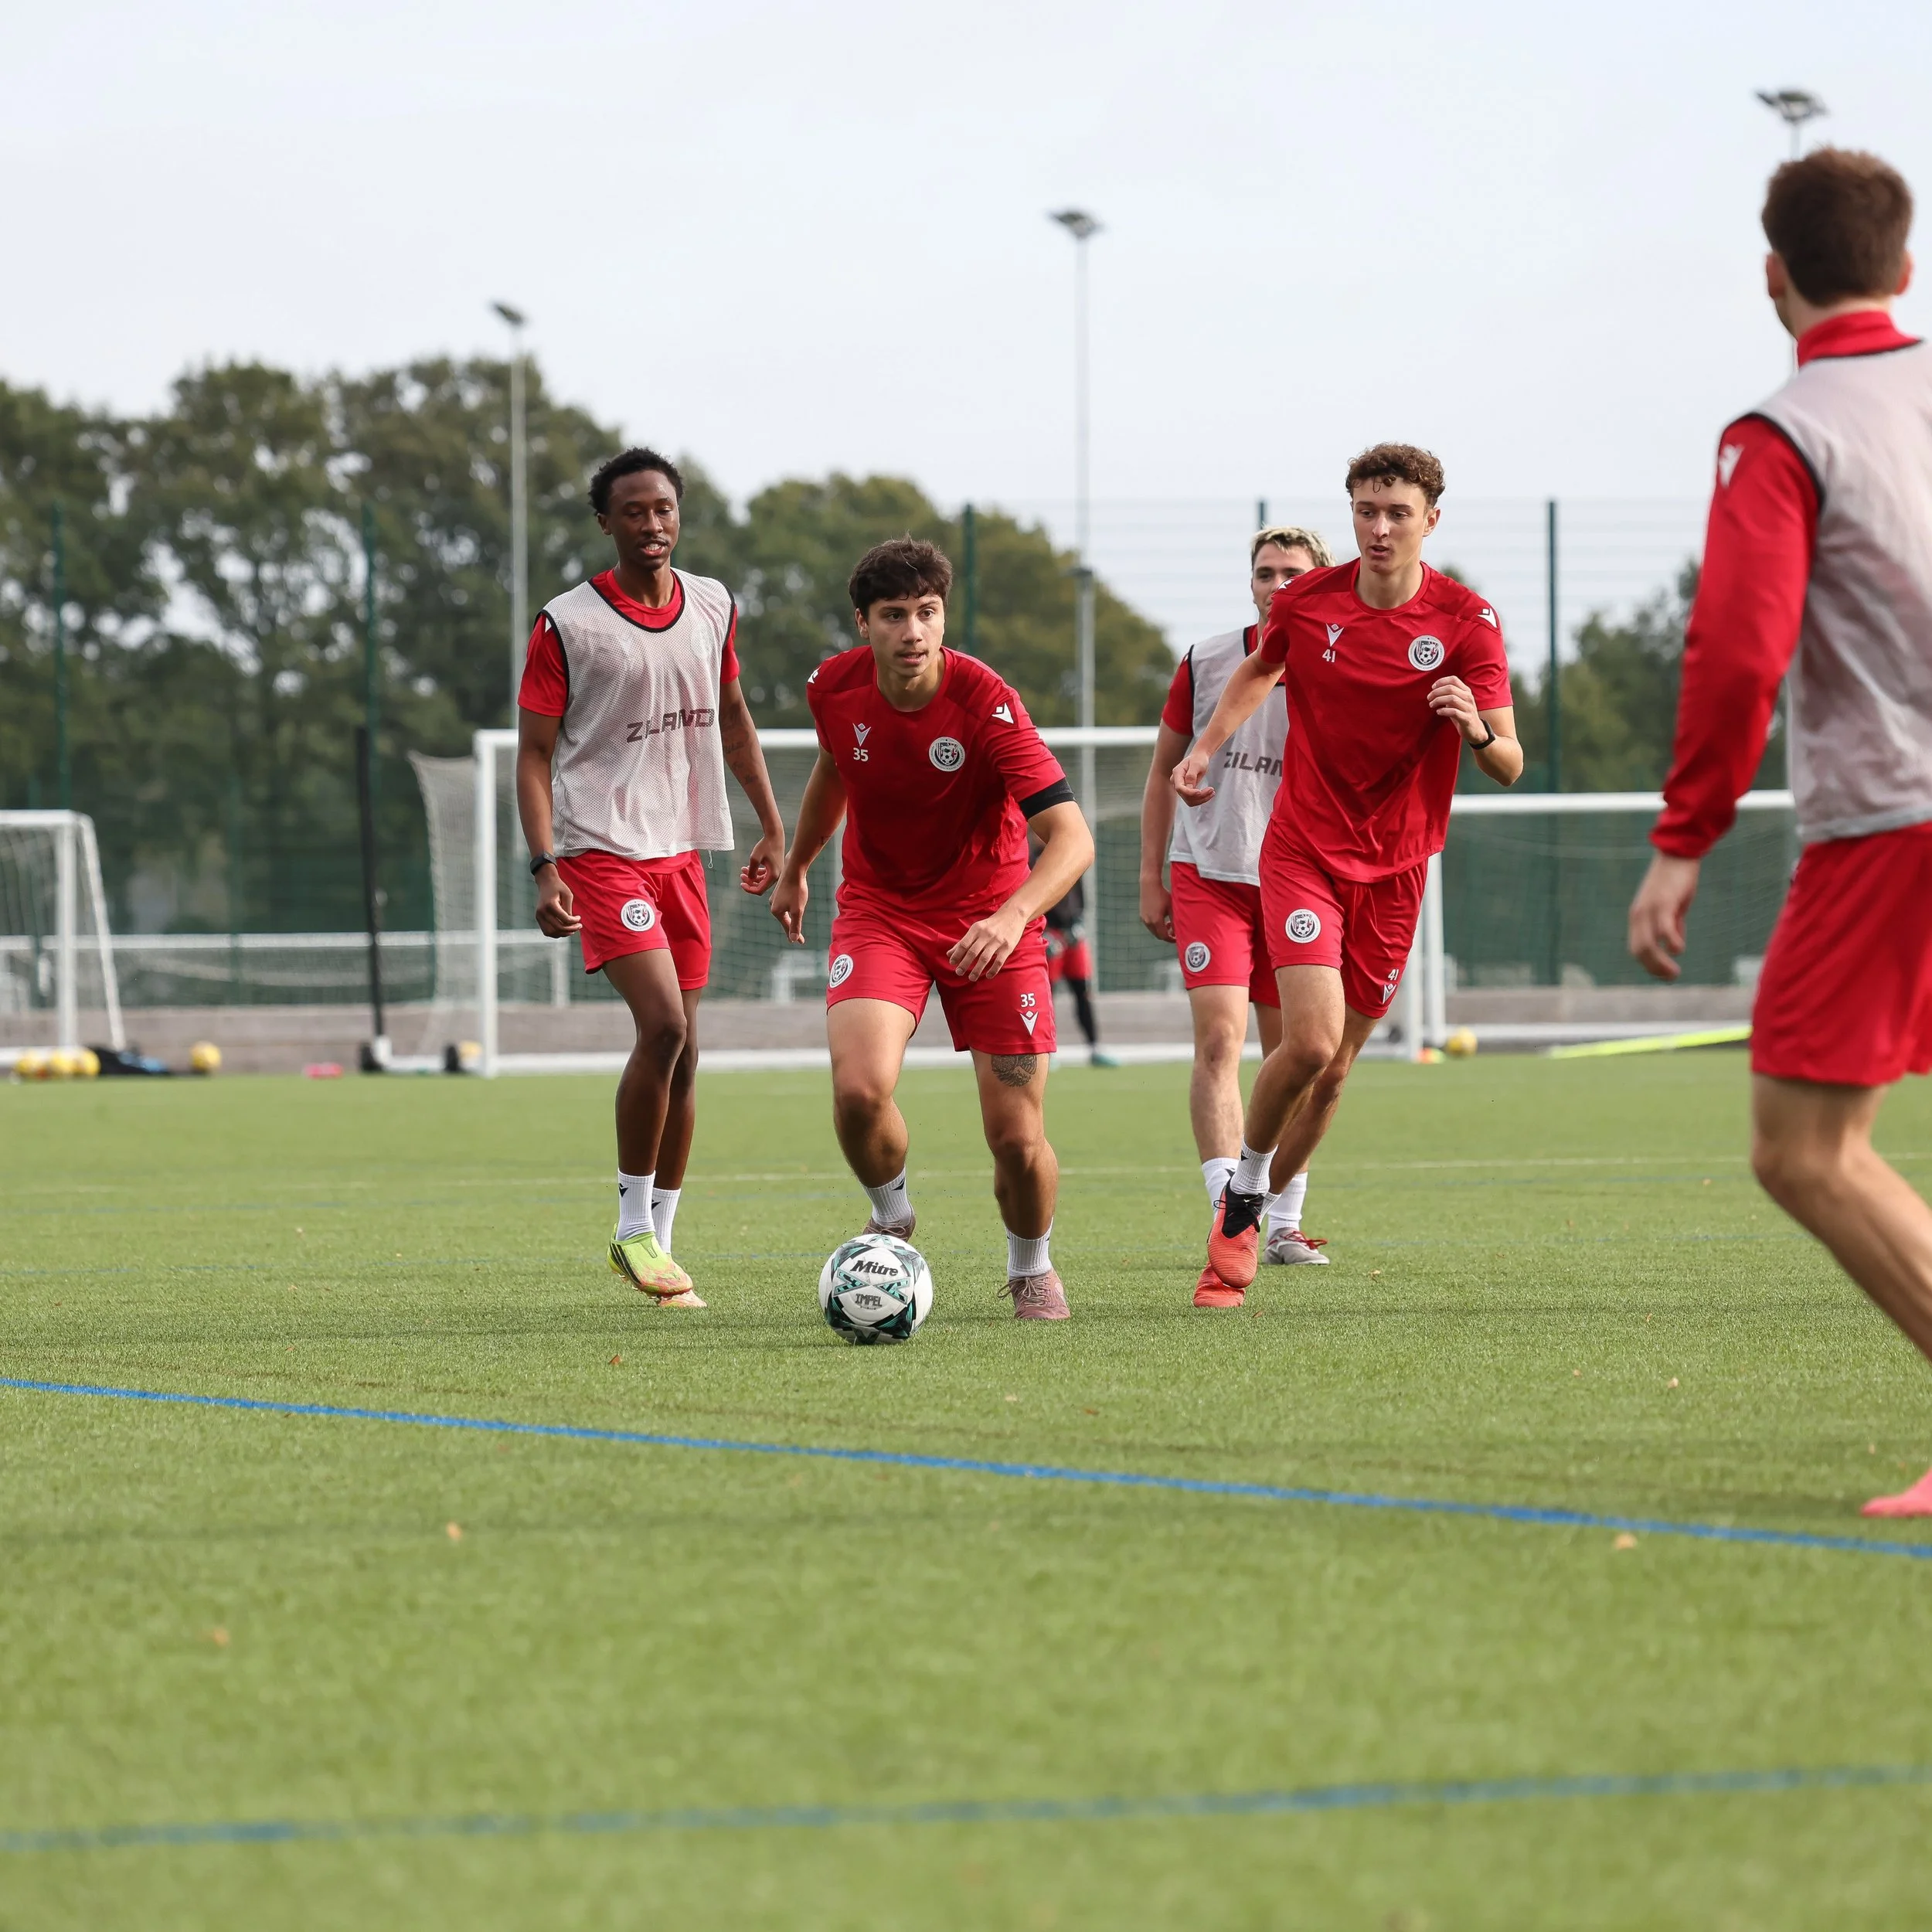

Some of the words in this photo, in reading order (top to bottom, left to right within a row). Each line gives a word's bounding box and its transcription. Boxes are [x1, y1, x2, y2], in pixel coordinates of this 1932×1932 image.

[1321, 648, 1336, 663] 41
[852, 747, 869, 762] 35
[1387, 968, 1400, 981] 41
[1020, 992, 1036, 1008] 35
[849, 1260, 899, 1277] Mitre
[855, 1293, 883, 1307] IMPEL
